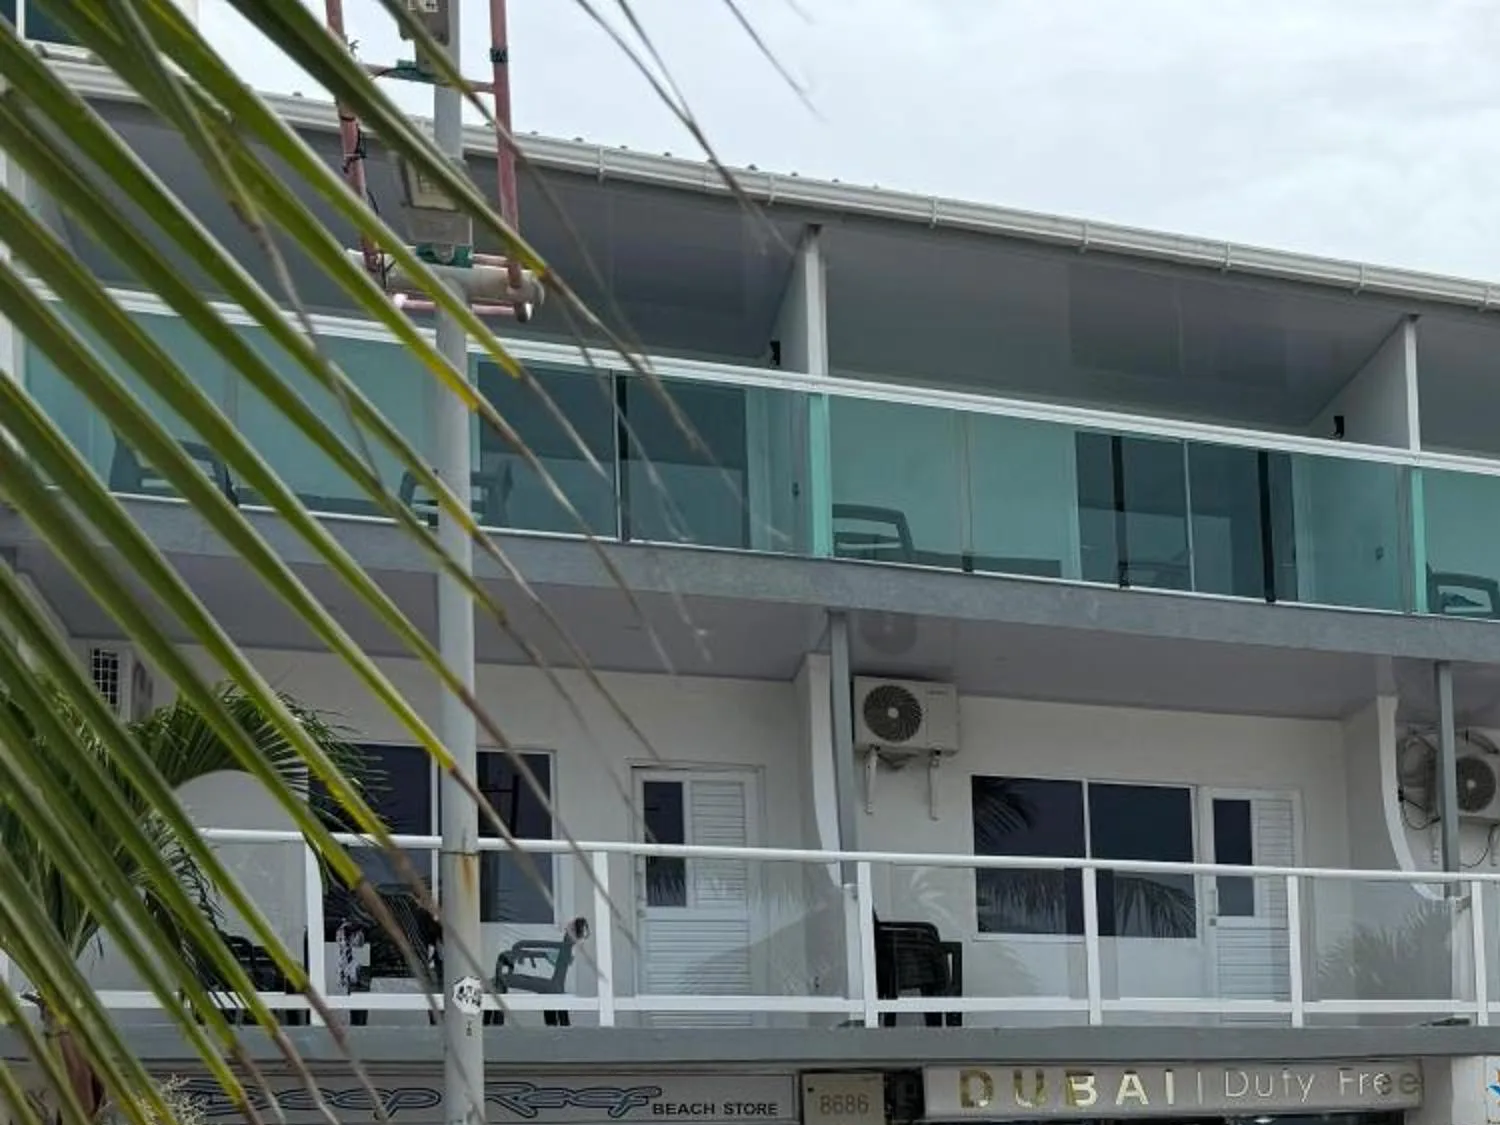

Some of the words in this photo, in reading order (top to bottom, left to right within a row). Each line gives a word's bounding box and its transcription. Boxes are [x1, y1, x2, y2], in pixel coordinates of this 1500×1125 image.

[959, 1069, 1175, 1108] DUBAI
[1223, 1068, 1315, 1104] Duty
[1338, 1066, 1425, 1096] Free
[652, 1102, 716, 1116] BEACH
[723, 1102, 778, 1116] STORE
[820, 1092, 870, 1115] 8686
